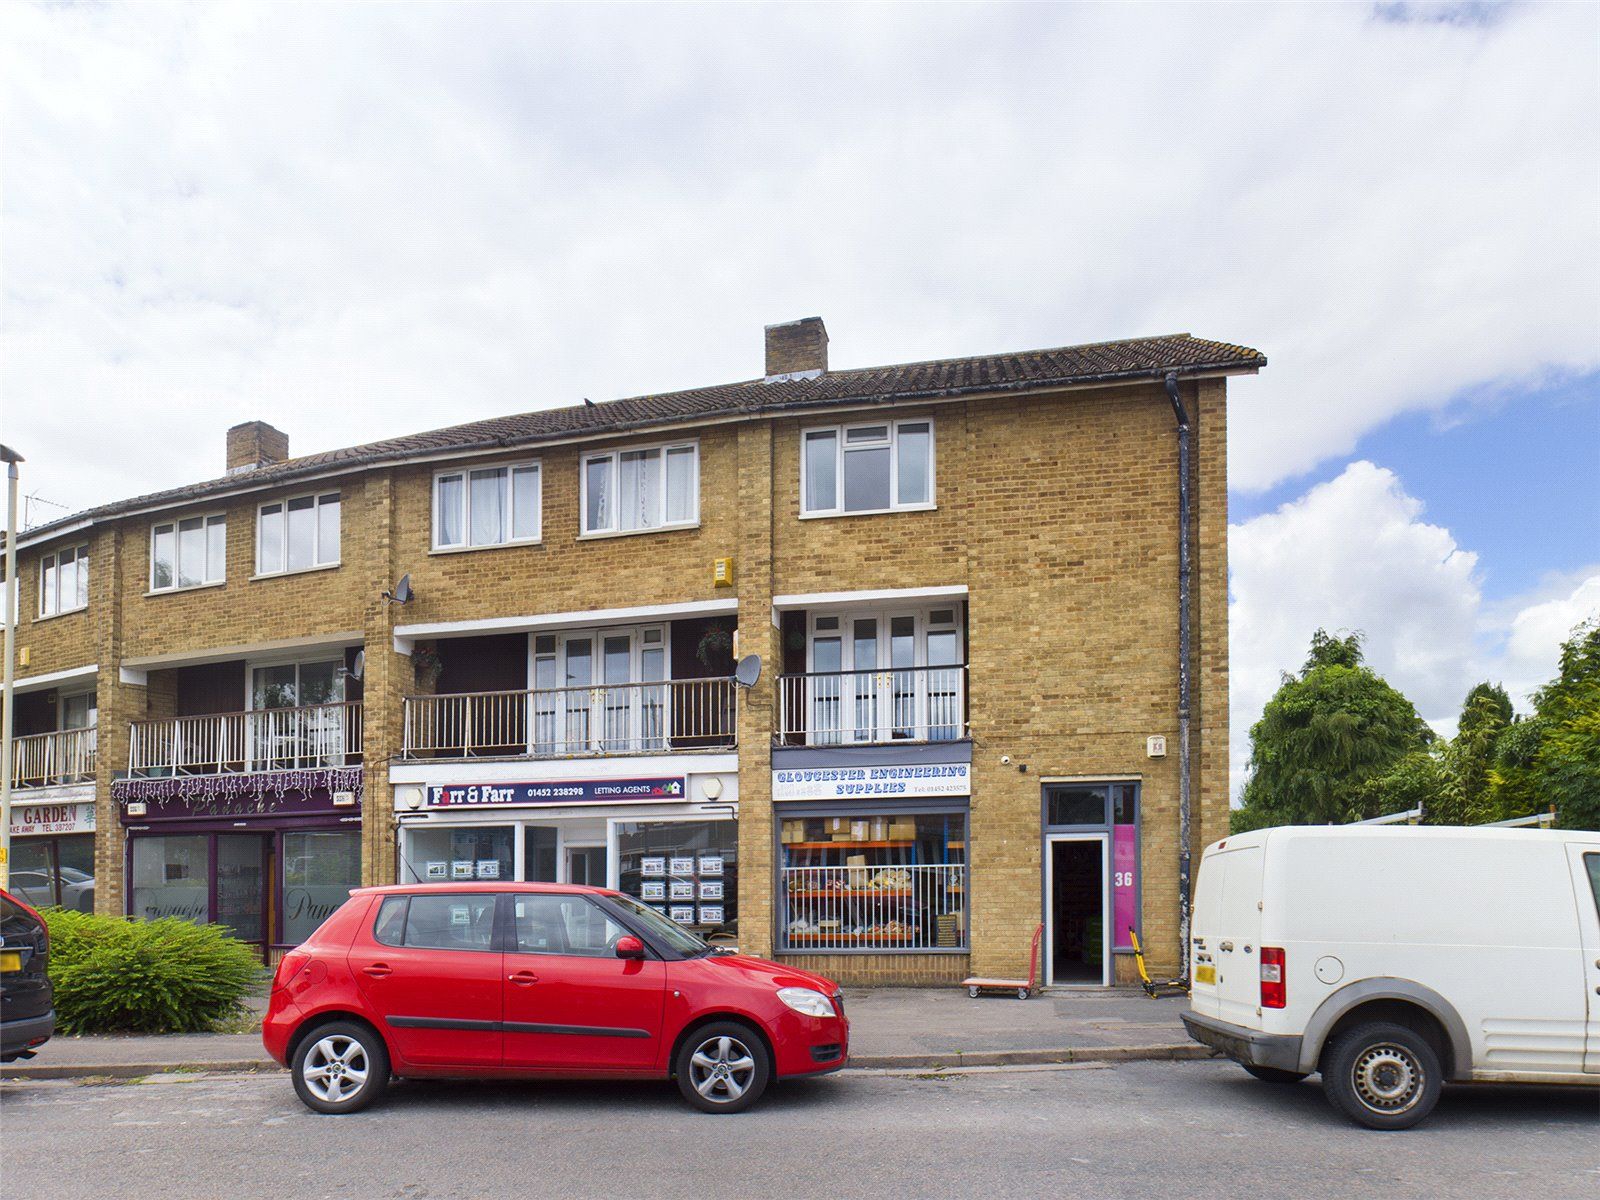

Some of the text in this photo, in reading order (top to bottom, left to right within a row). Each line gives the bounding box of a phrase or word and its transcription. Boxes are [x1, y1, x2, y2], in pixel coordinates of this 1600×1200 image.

[777, 766, 967, 783] GLOUCESTER ENGINEERING
[432, 785, 515, 804] Farr & Farr
[527, 787, 584, 797] 01452 238298
[594, 785, 651, 795] LETTING AGENTS
[836, 782, 906, 795] SUPPLIES
[191, 795, 278, 817] Panache
[24, 805, 77, 824] GARDEN
[1114, 871, 1133, 887] 36
